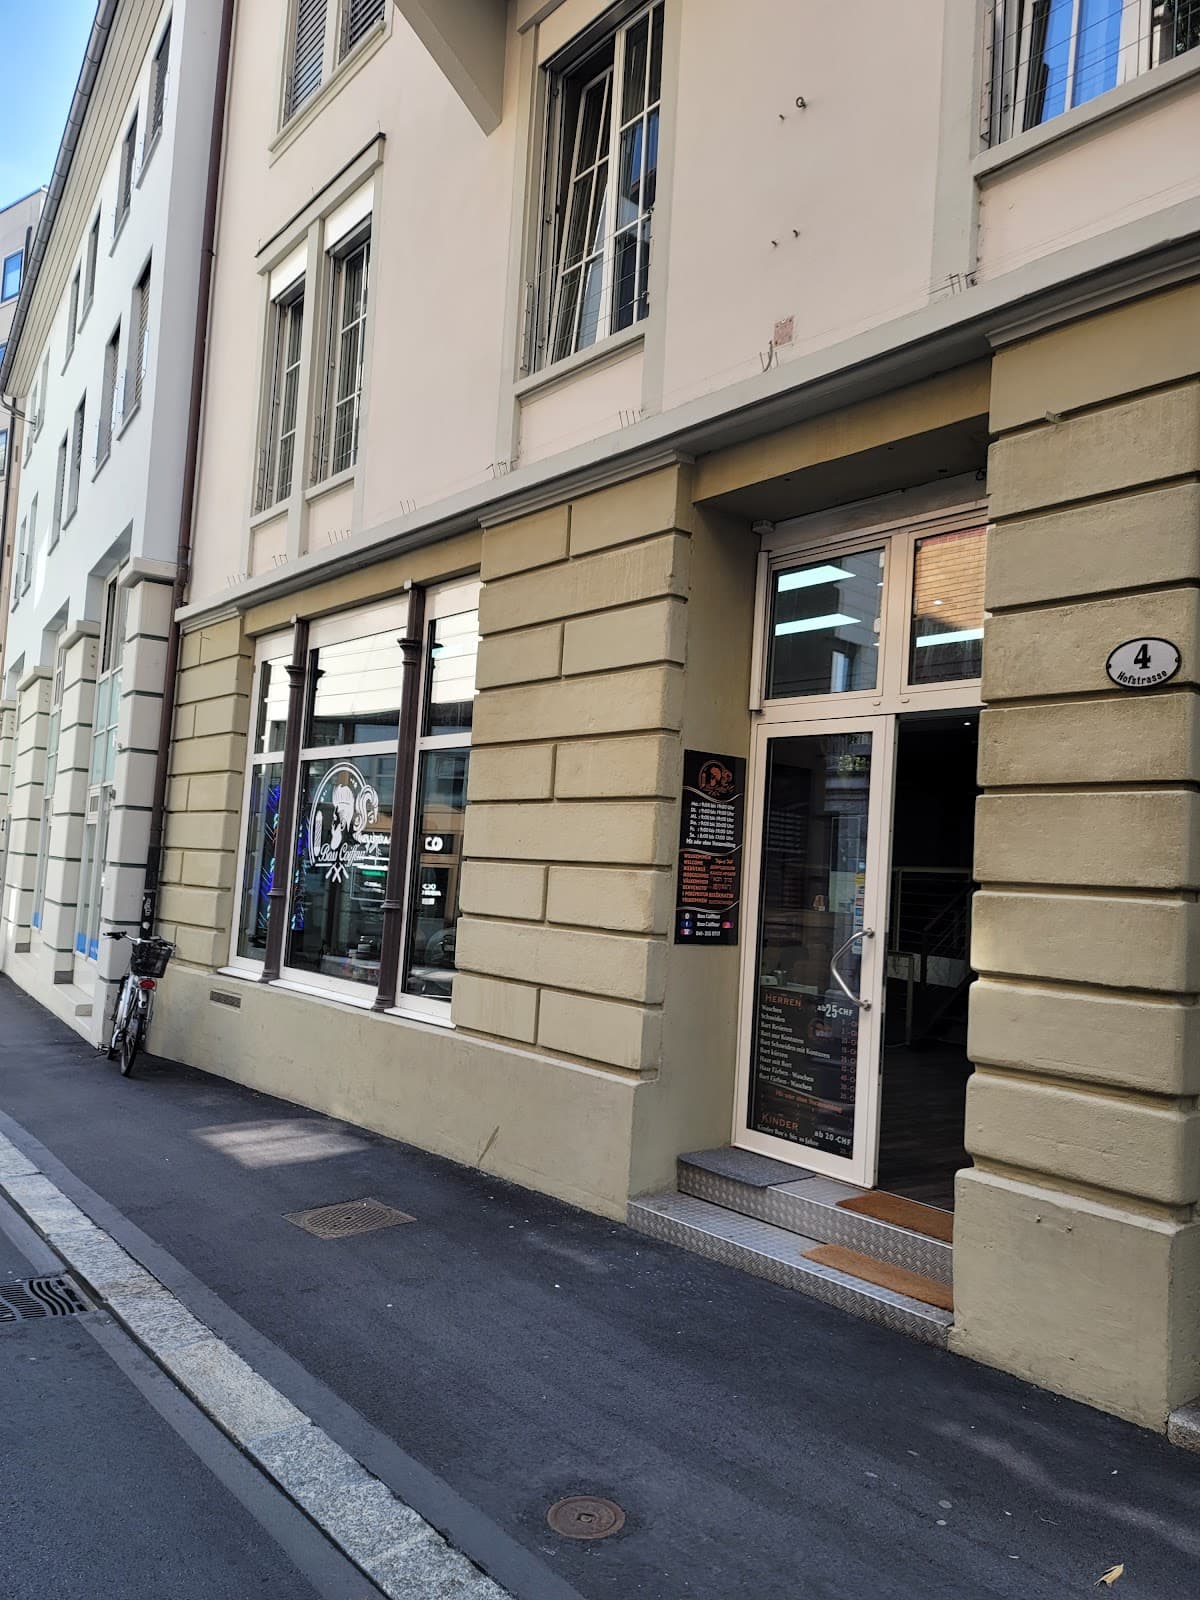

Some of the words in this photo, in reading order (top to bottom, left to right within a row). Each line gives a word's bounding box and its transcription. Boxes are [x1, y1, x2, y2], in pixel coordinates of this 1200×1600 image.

[1134, 644, 1151, 669] 4
[1117, 670, 1167, 685] Hofstrasse
[766, 994, 801, 1007] HERREN
[762, 1114, 798, 1131] KINDER
